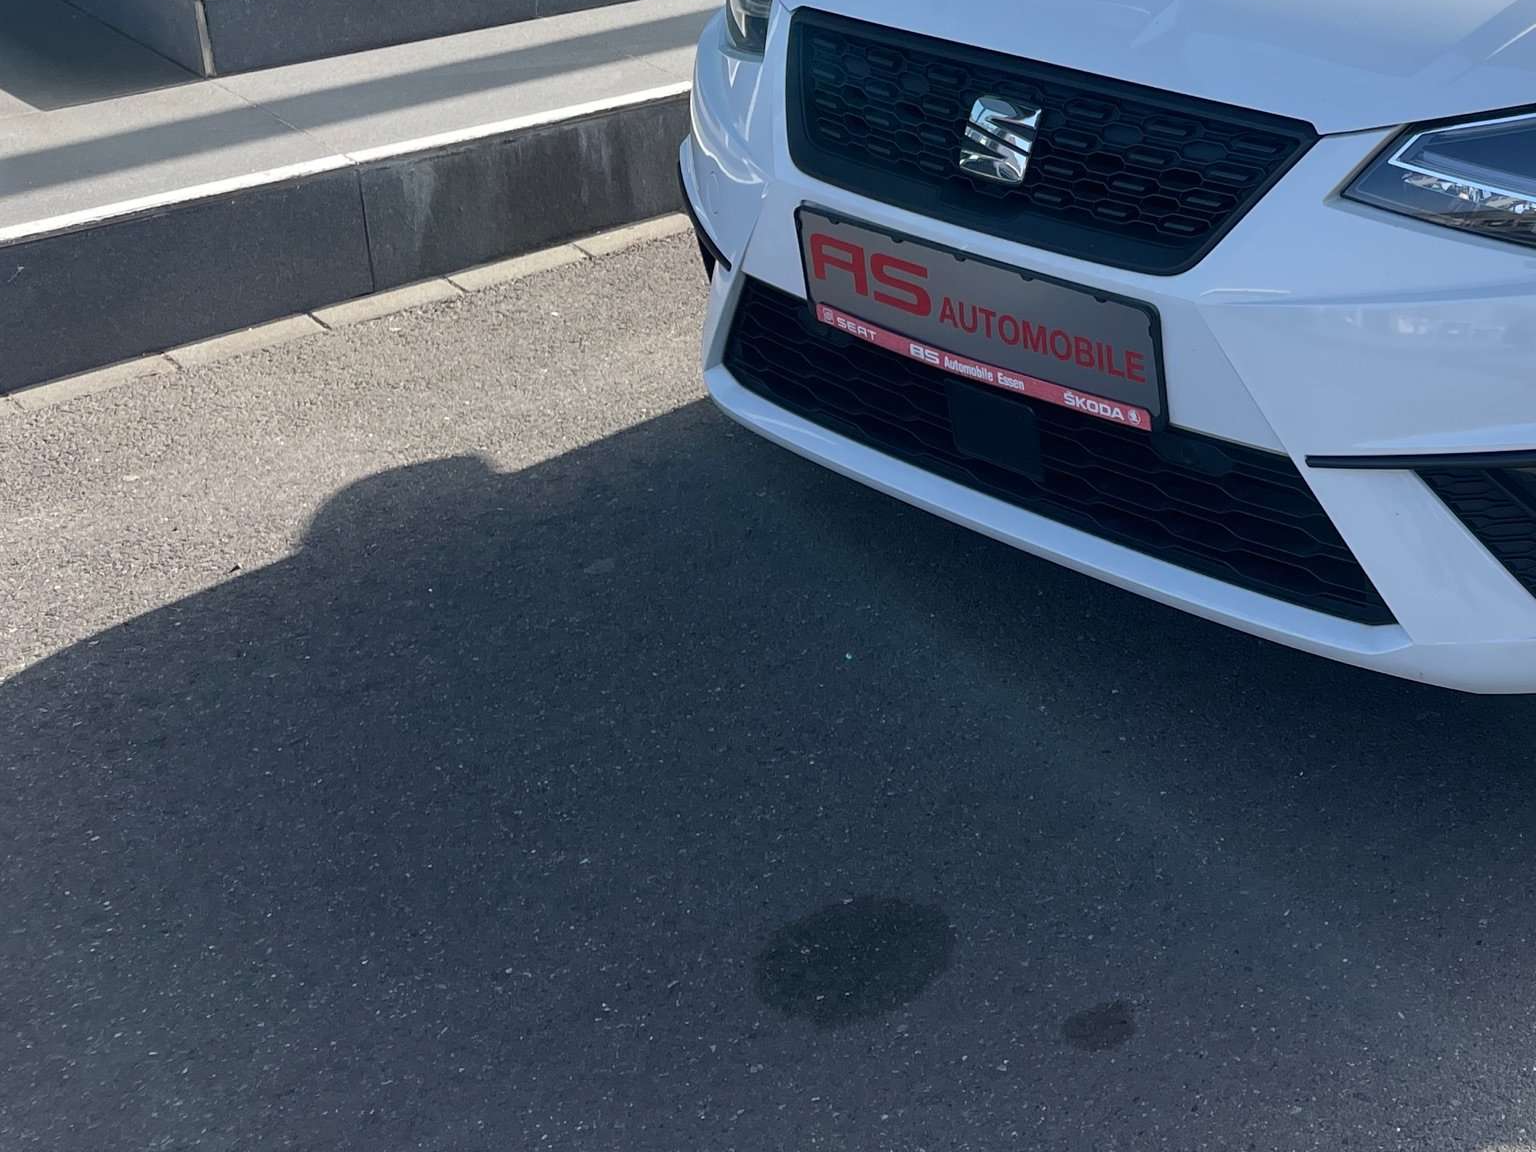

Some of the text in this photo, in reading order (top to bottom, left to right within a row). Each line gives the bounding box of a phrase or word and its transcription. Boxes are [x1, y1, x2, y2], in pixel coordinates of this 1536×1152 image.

[810, 233, 1147, 383] AS AUTOMOBILE
[836, 317, 1126, 422] SEAT AS Automobile Essen ŠKODA
